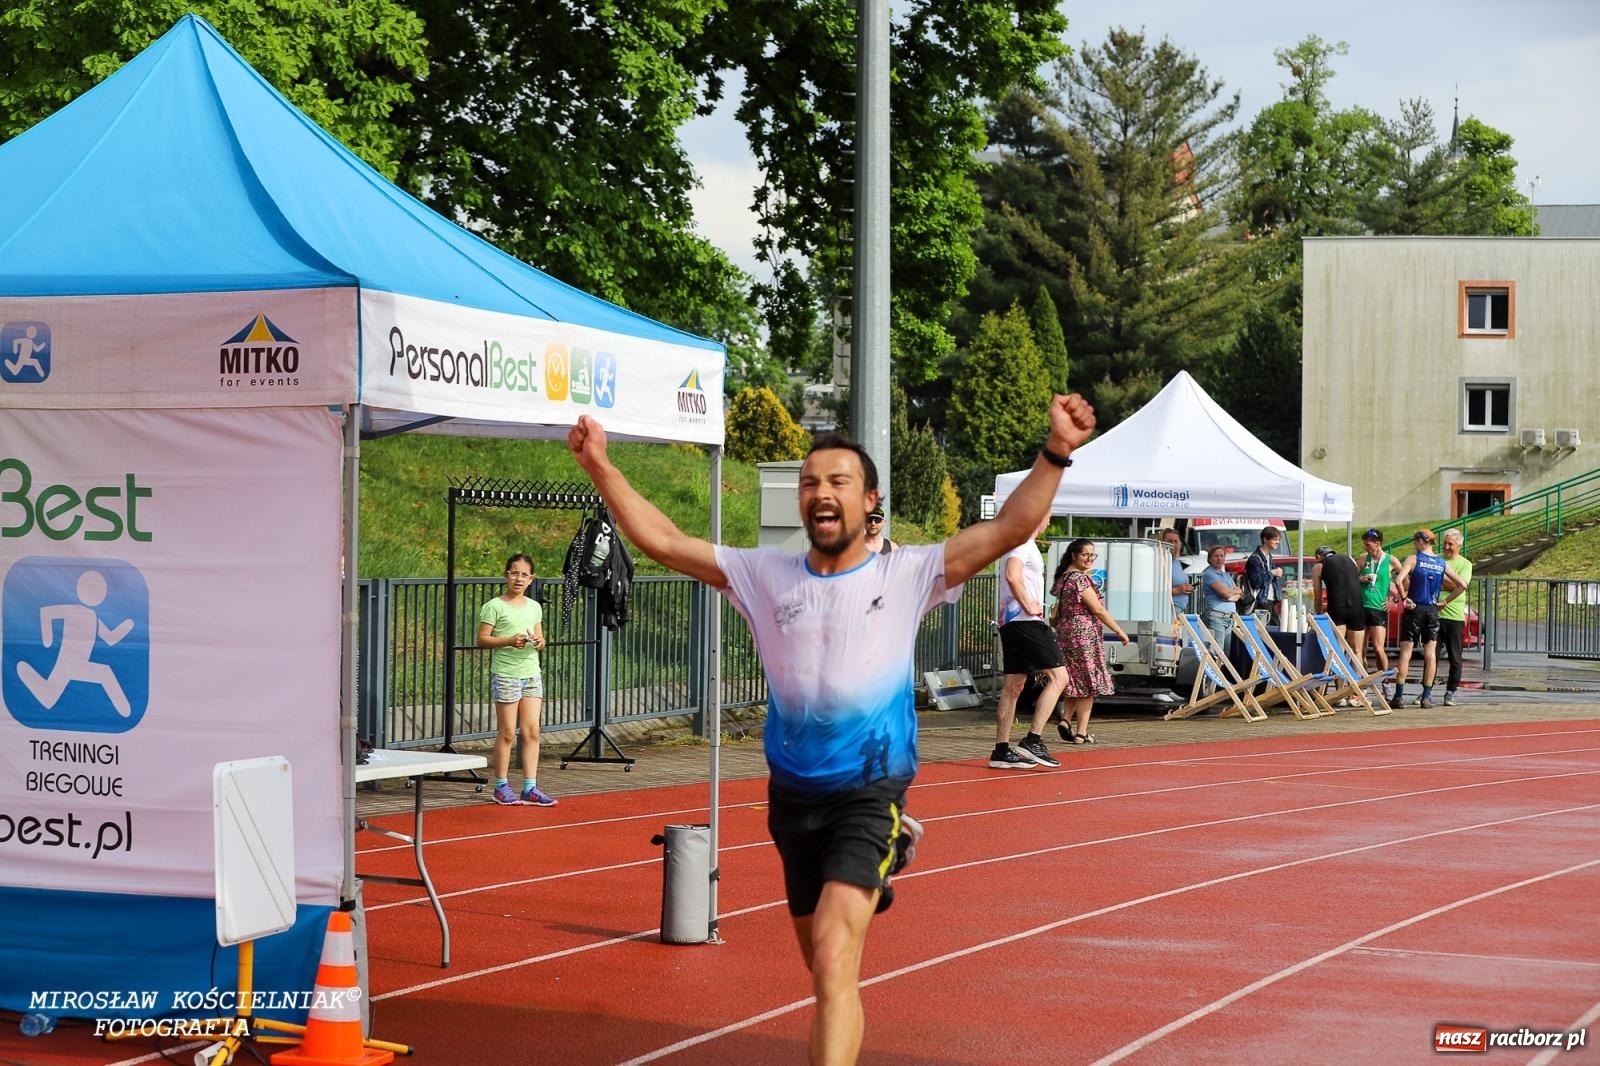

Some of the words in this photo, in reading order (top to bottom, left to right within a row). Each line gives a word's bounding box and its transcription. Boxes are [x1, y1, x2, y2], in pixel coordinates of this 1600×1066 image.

[219, 346, 299, 375] MITKO
[389, 326, 538, 392] PersonalBest
[220, 377, 241, 387] for
[250, 376, 300, 387] events
[677, 391, 707, 415] MITKO
[1132, 488, 1190, 501] Wodociągi
[1132, 500, 1190, 509] Raciborskie
[29, 740, 119, 765] TRENINGI
[26, 771, 123, 797] BIEGOWE
